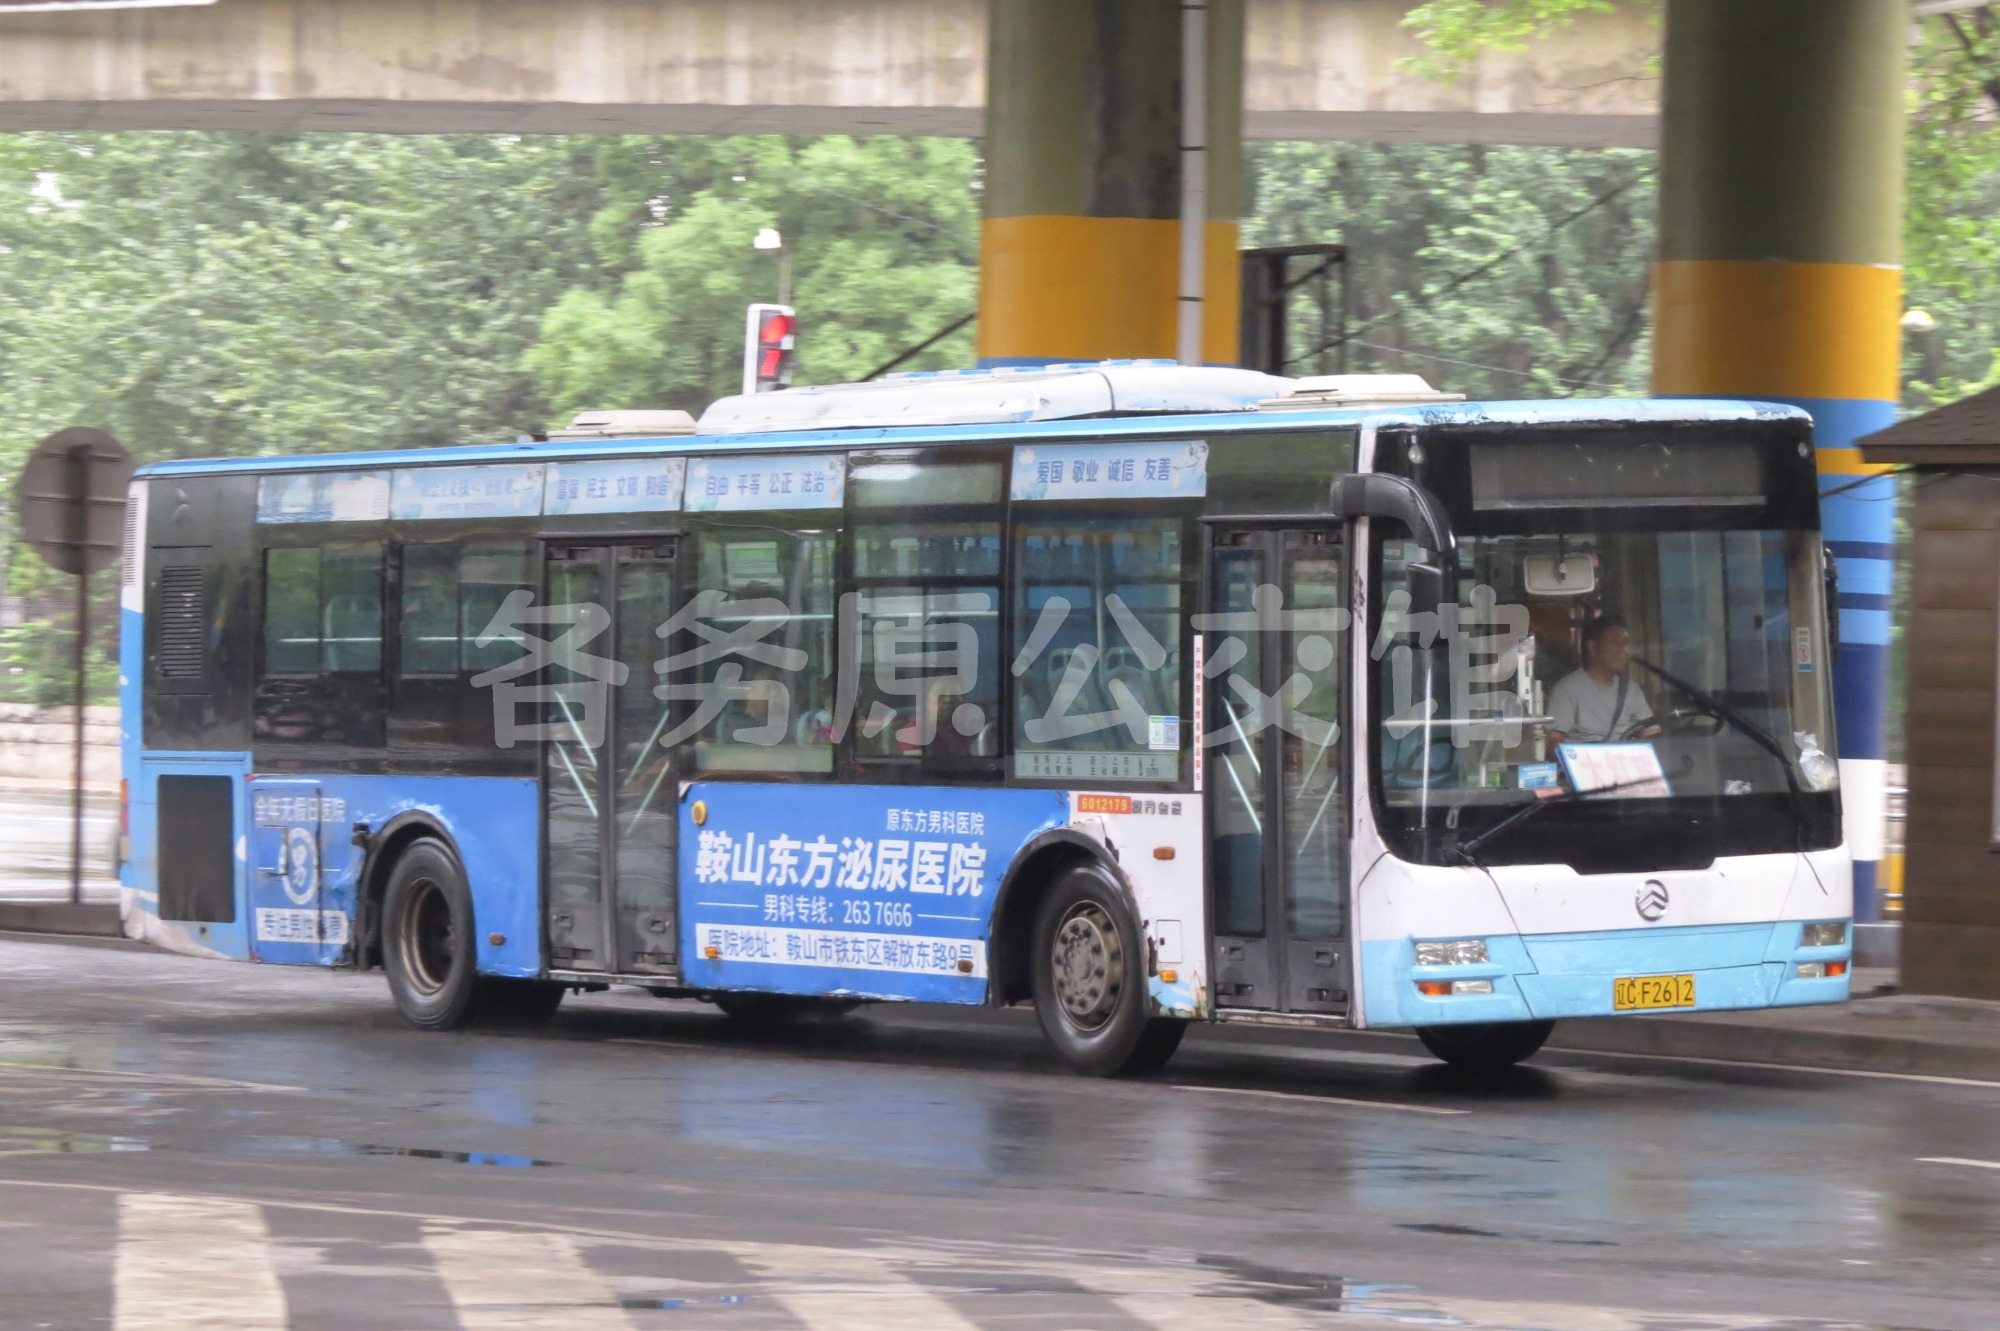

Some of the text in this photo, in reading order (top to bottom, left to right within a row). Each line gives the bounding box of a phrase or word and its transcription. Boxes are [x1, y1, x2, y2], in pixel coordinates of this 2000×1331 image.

[706, 471, 825, 496] 自由 平等 公正 法治
[1037, 457, 1172, 484] 爱国 敬业 诚信 友善
[586, 477, 607, 499] 民主
[1081, 797, 1128, 812] 6012179
[886, 807, 985, 836] 原东方男科医院
[695, 830, 988, 897] 鞍山东方泌尿医院
[874, 901, 913, 928] 7666
